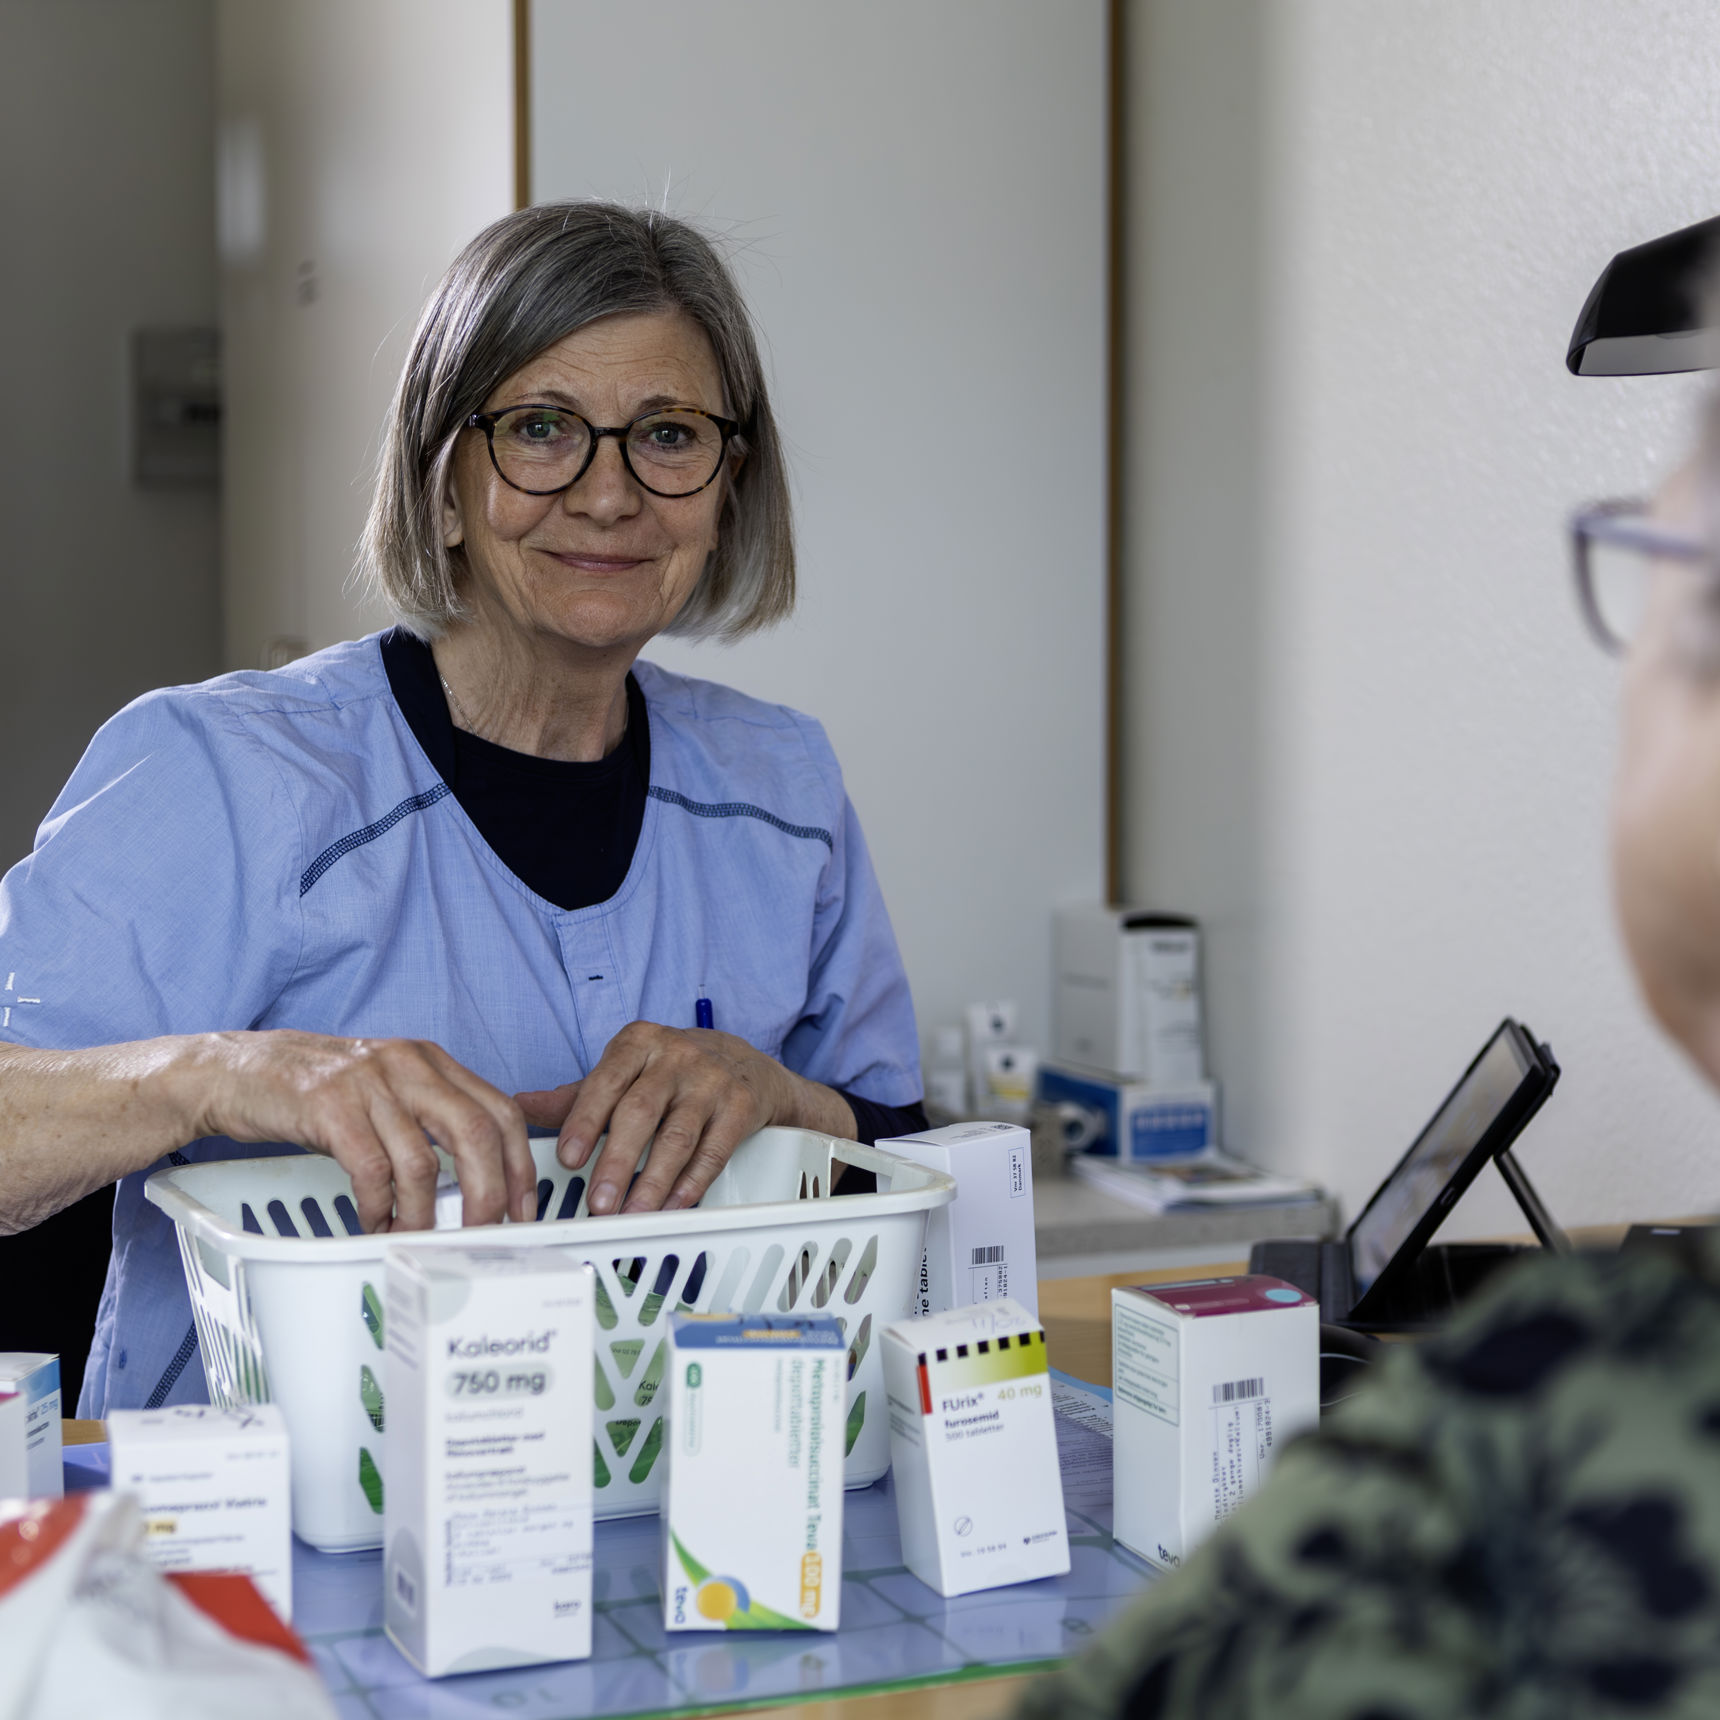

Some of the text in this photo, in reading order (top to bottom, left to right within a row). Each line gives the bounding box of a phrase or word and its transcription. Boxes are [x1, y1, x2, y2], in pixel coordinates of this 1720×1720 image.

[453, 1370, 546, 1396] 750 mg
[998, 1387, 1016, 1401] 40
[1020, 1384, 1043, 1399] mg
[944, 1410, 1000, 1428] furosemid
[806, 1515, 821, 1551] Teva
[1158, 1544, 1180, 1568] teva
[804, 1555, 820, 1587] 100
[674, 1586, 688, 1624] teva
[801, 1590, 819, 1616] mg
